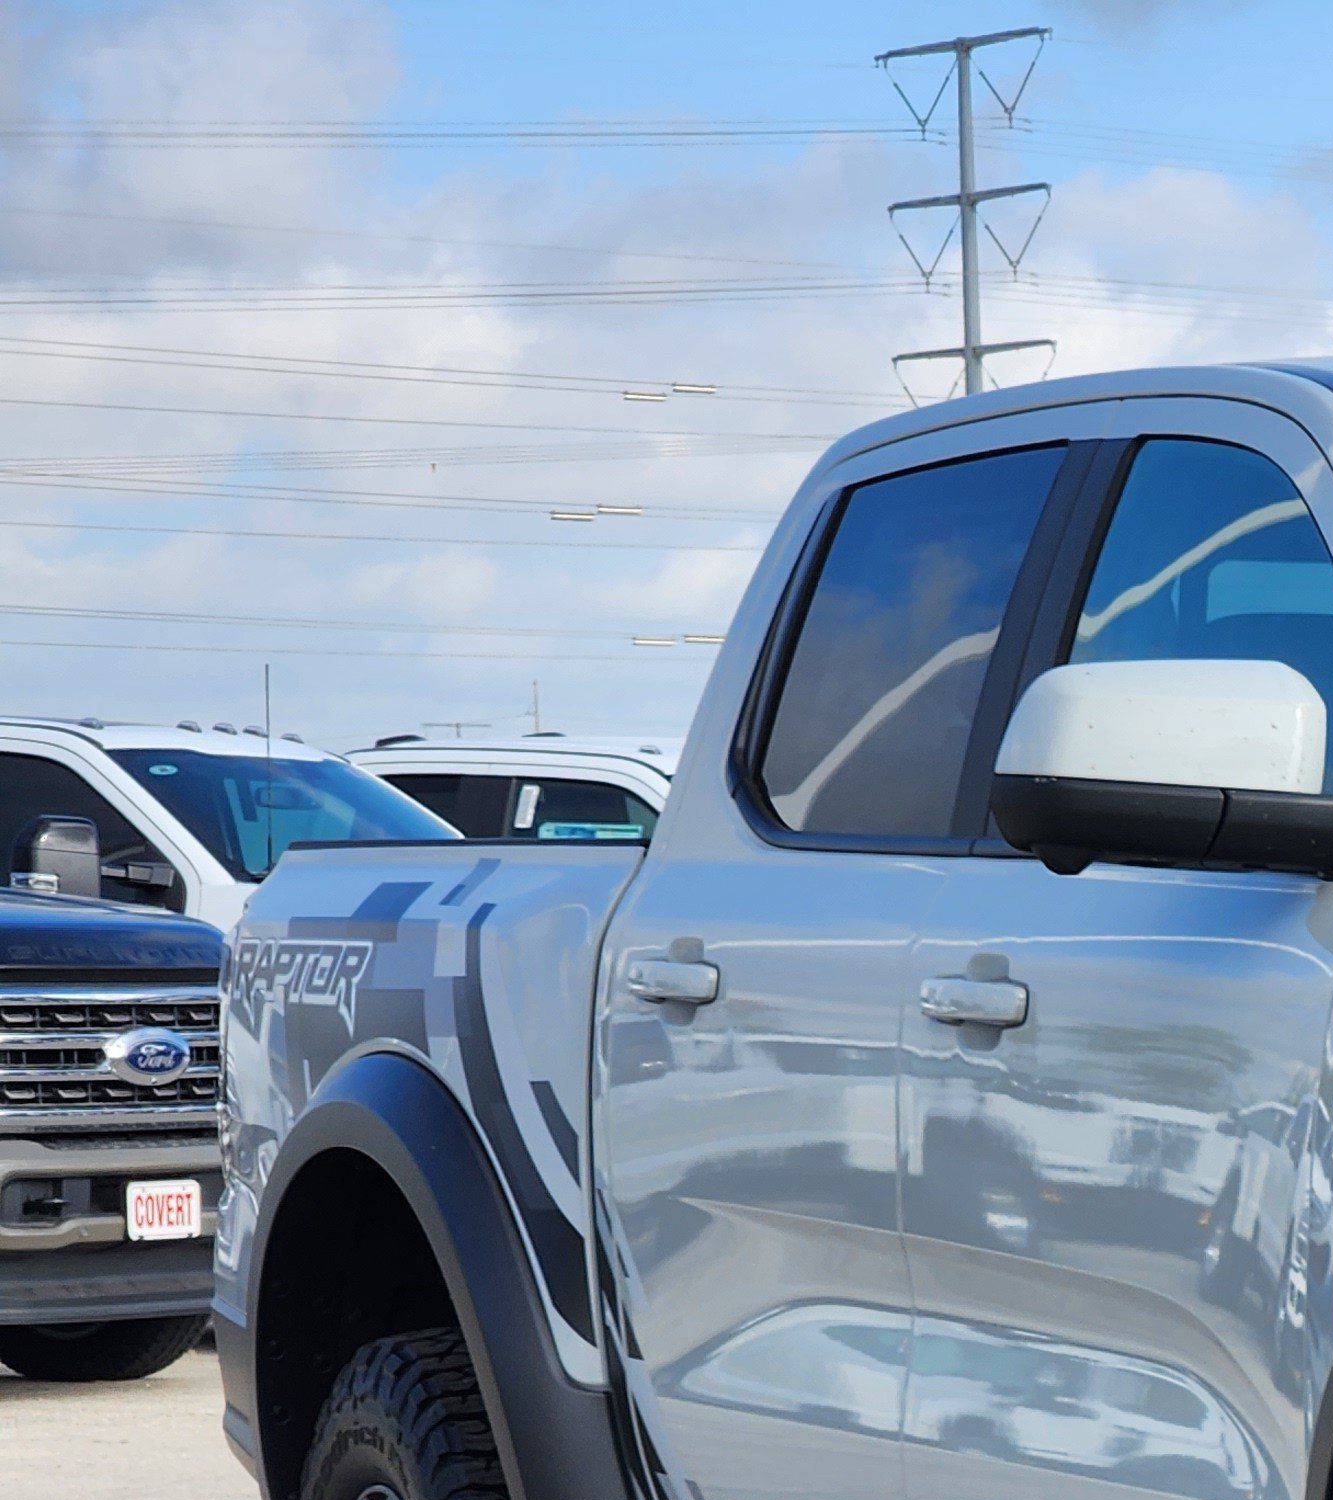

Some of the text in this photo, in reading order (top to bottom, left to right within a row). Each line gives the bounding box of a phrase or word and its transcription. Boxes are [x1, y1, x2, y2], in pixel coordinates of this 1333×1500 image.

[233, 937, 374, 1039] RAPTOR
[136, 1043, 178, 1069] Ford
[134, 1193, 193, 1229] COVERT
